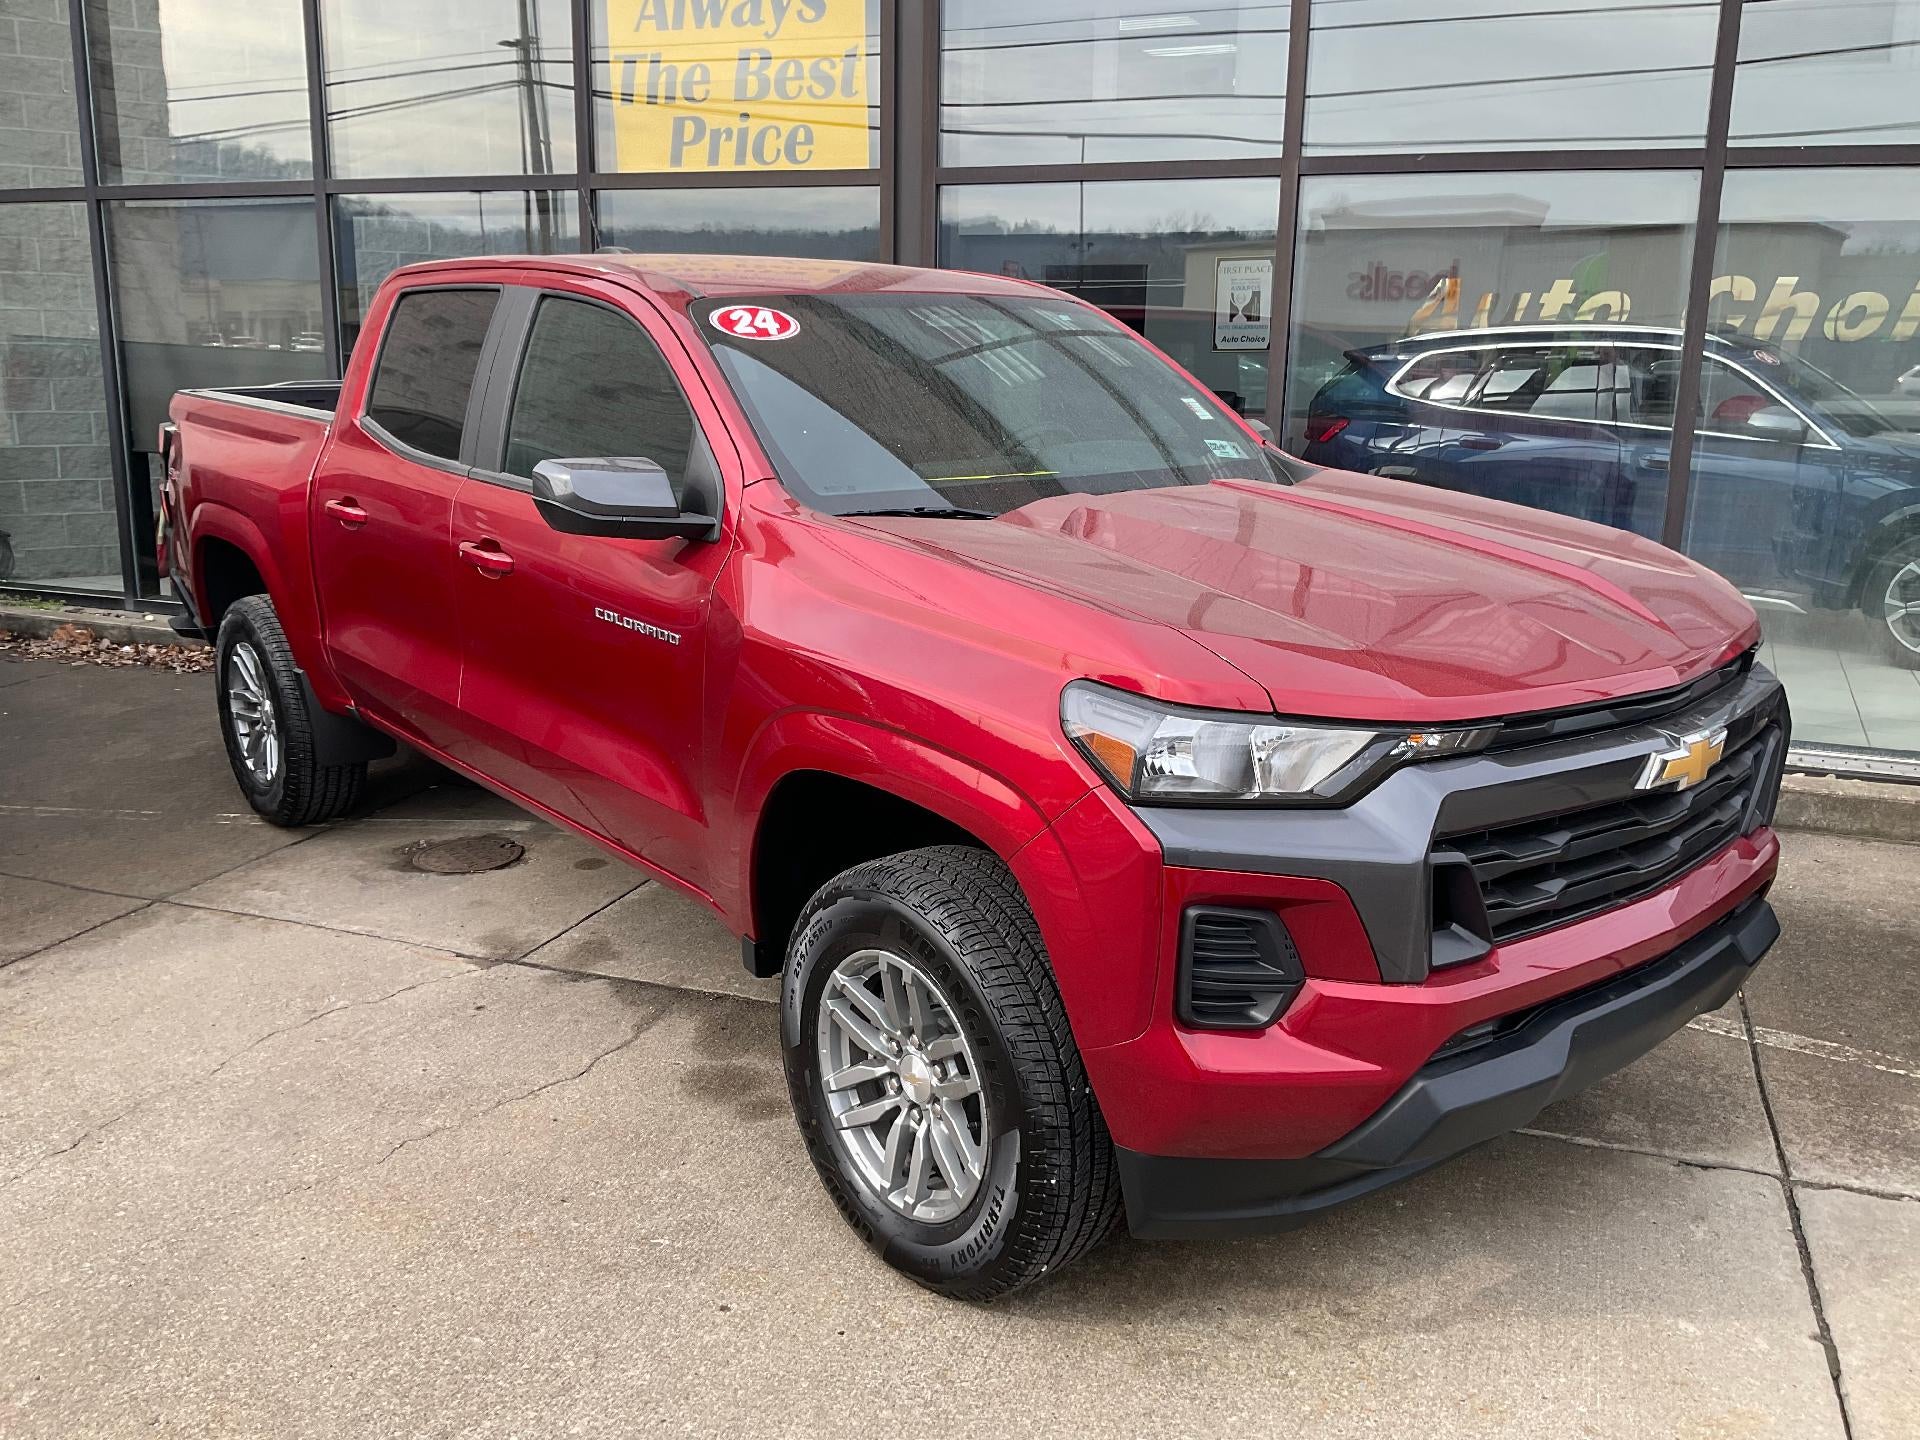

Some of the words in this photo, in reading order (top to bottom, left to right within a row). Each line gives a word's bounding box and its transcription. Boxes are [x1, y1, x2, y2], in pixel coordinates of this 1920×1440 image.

[634, 0, 829, 39] Always
[613, 52, 711, 106] The
[733, 43, 863, 102] Best
[669, 113, 815, 168] Price
[729, 309, 781, 335] 24
[1403, 276, 1632, 336] Auto
[1220, 335, 1239, 343] Auto
[1240, 335, 1266, 343] Choice
[595, 607, 681, 646] COLORADO
[950, 1184, 1006, 1270] TERRITORY
